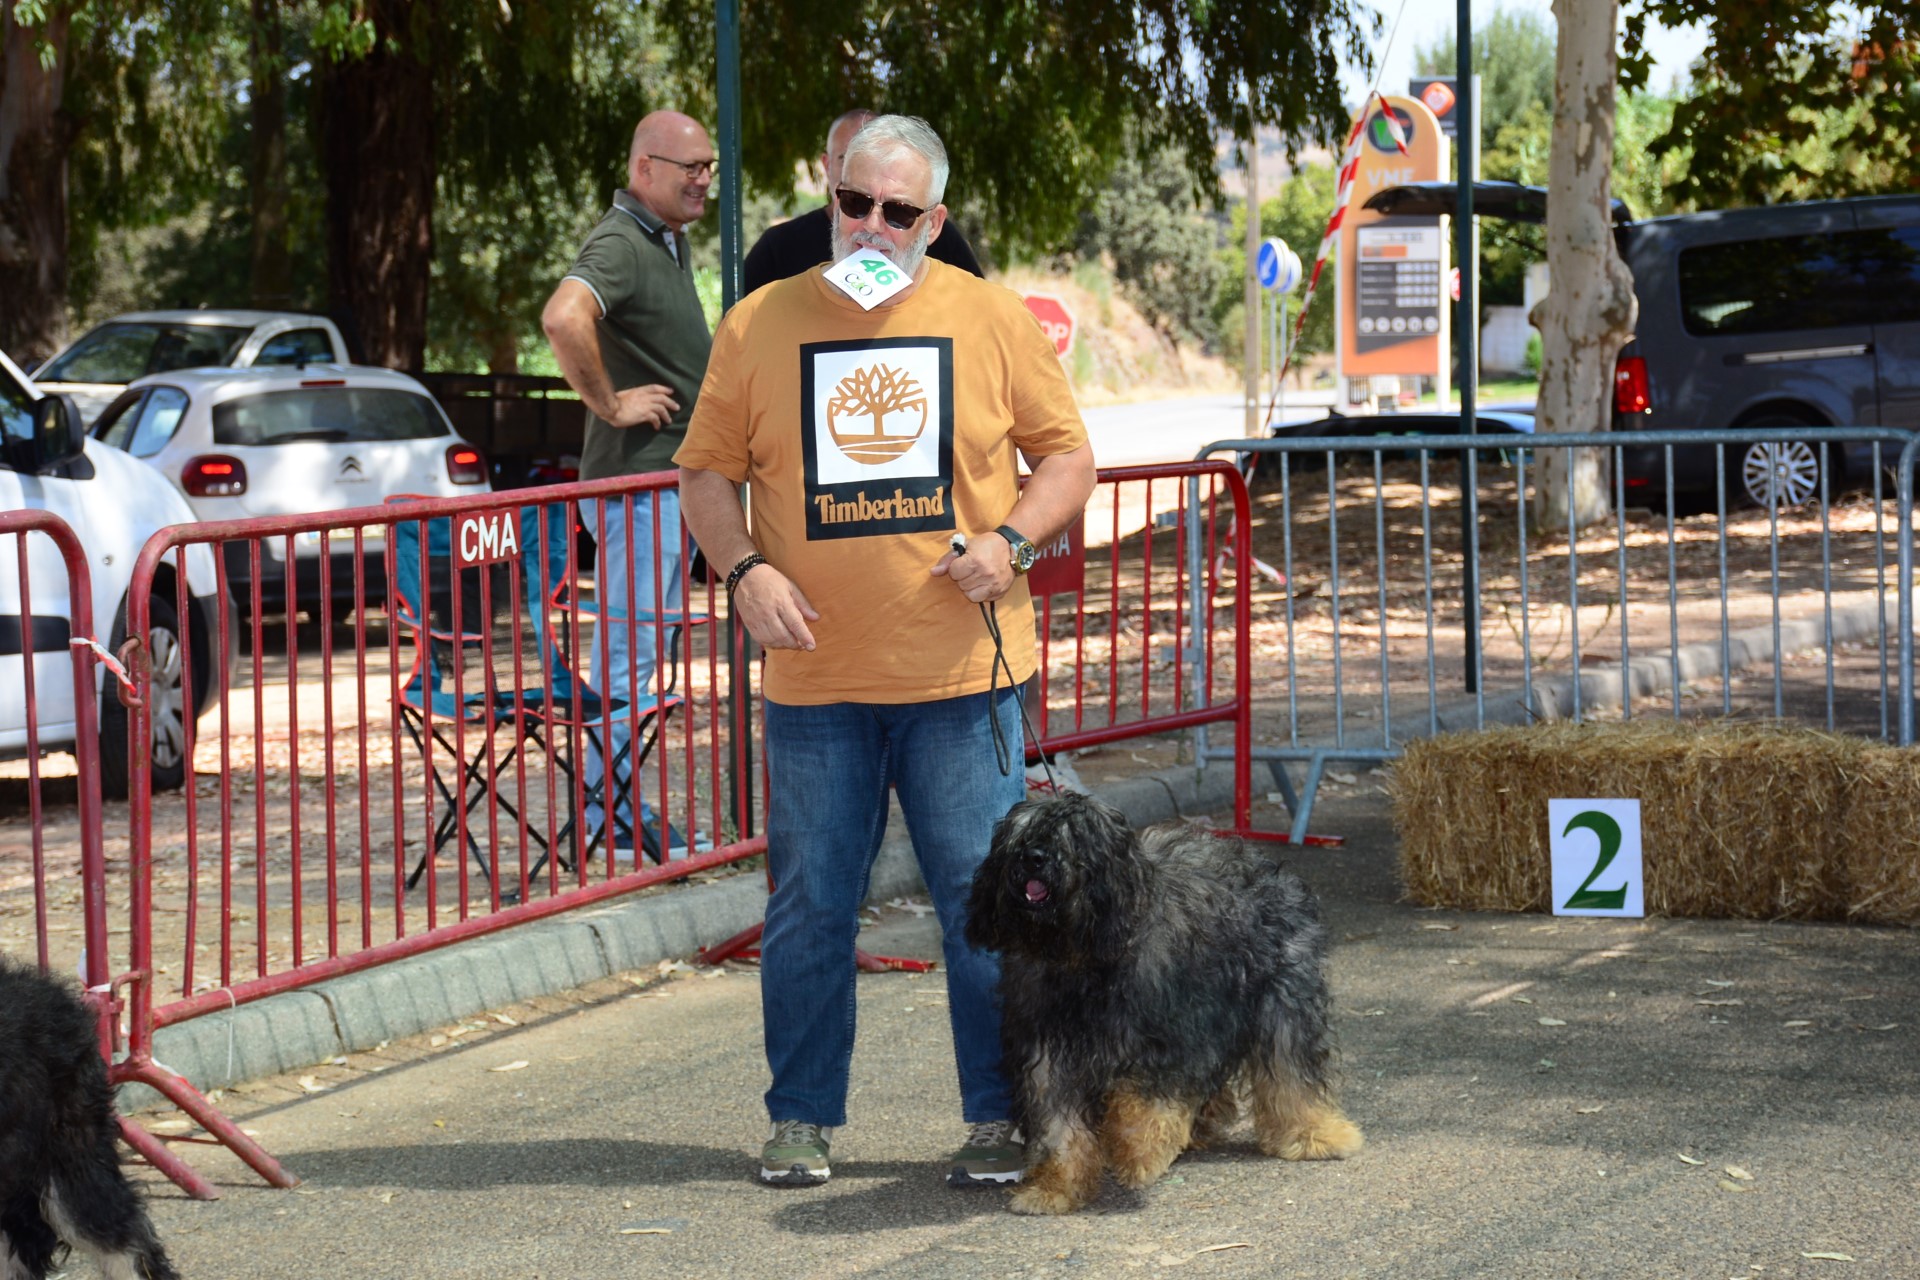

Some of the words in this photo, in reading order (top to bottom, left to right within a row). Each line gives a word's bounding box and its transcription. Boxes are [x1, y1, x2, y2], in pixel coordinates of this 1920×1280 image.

[860, 259, 899, 286] 46
[1039, 320, 1069, 342] OP
[815, 486, 945, 524] Timberland
[460, 512, 518, 562] CMA
[1562, 810, 1628, 910] 2
